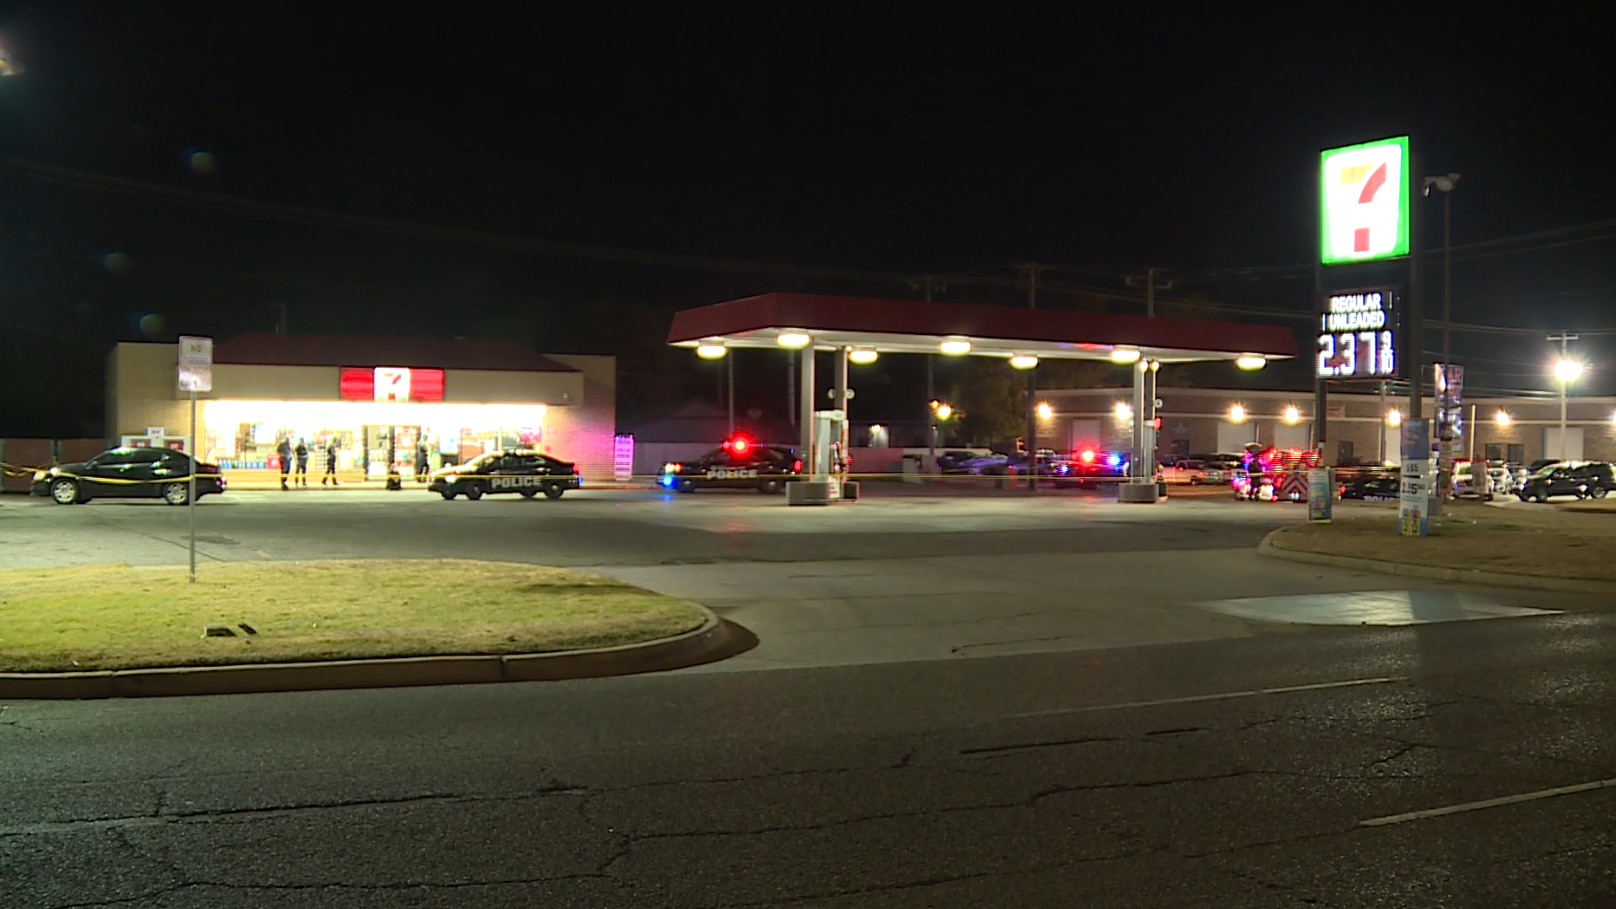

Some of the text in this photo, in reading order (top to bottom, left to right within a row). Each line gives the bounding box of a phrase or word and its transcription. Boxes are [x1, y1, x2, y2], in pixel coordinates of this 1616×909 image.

[1330, 293, 1383, 313] REGULAR
[1329, 310, 1386, 332] UNLEADED
[190, 344, 202, 353] NO
[1316, 331, 1376, 376] 2.37
[491, 475, 543, 488] POLICE
[707, 468, 758, 480] POLICE
